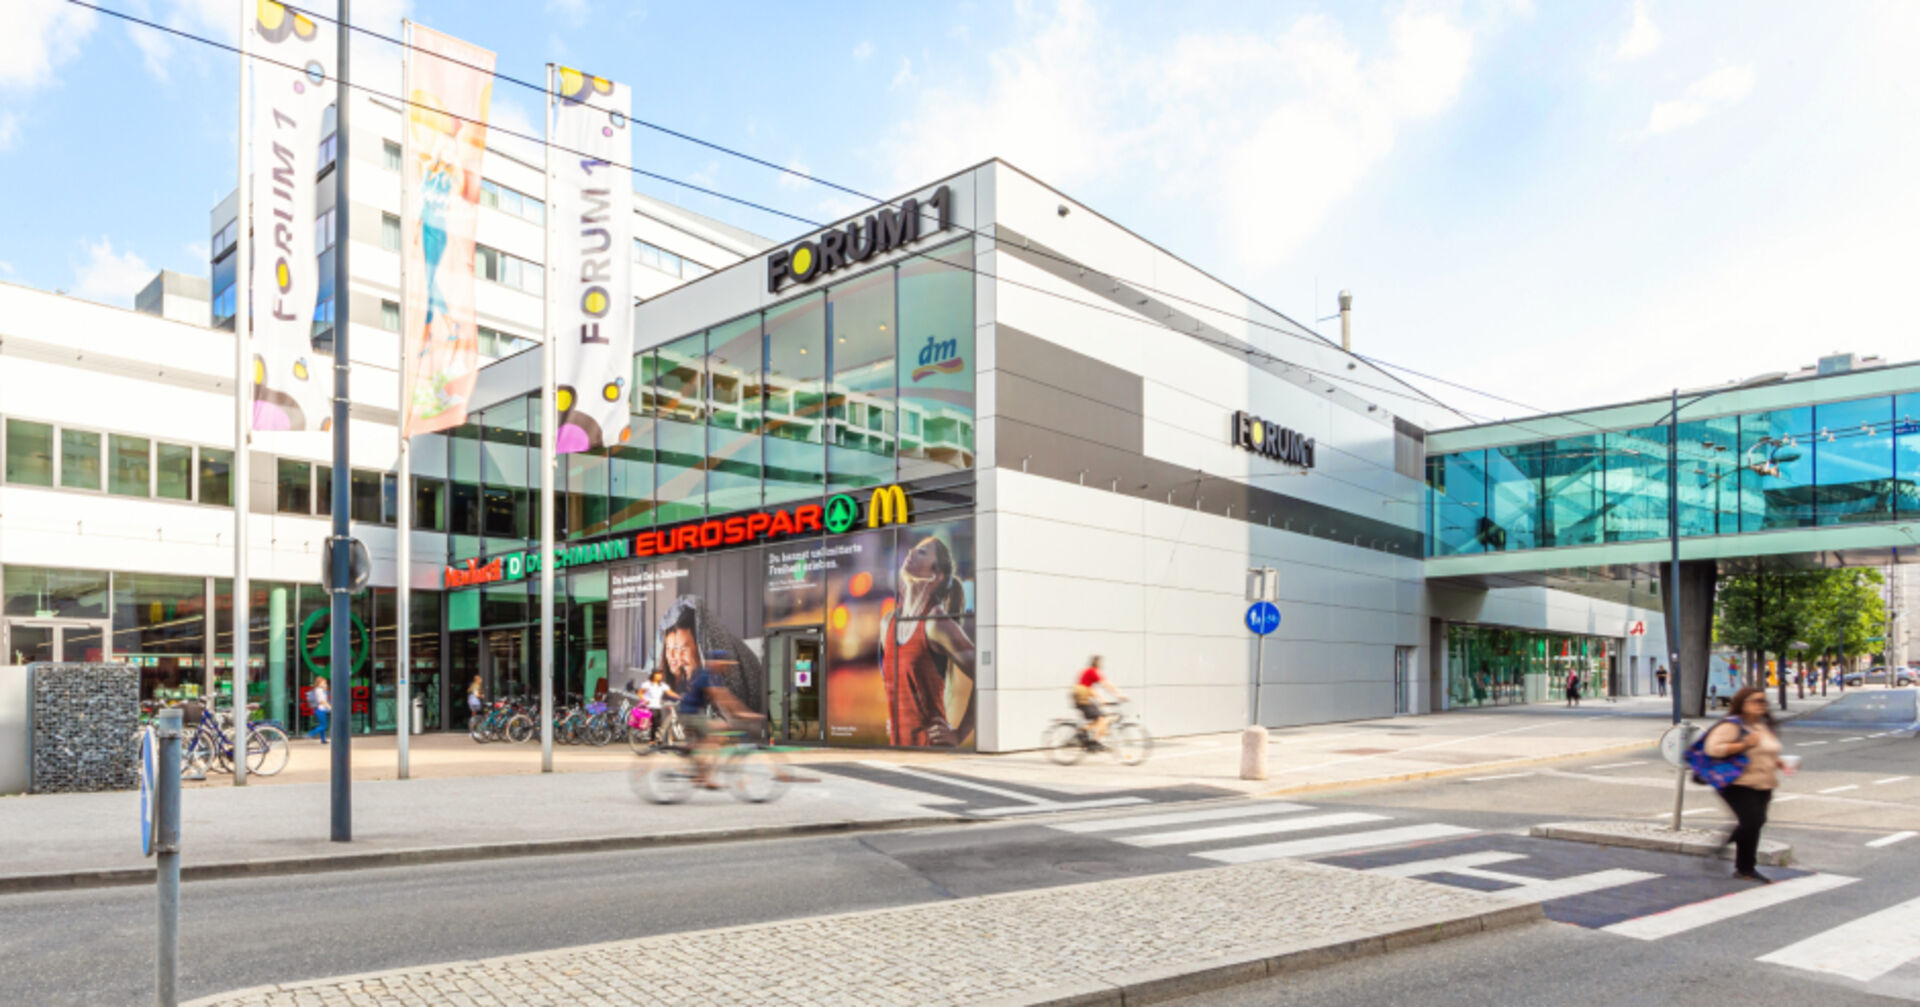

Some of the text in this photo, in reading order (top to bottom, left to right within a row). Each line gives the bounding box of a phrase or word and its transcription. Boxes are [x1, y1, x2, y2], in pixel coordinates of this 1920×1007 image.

[272, 107, 297, 129] 1
[580, 158, 612, 345] FORUM 1
[767, 185, 952, 293] FORUM 1
[918, 336, 957, 366] dm
[1231, 410, 1305, 466] FORUM
[526, 538, 626, 573] DECHMANN
[636, 504, 823, 556] EUROSPAR
